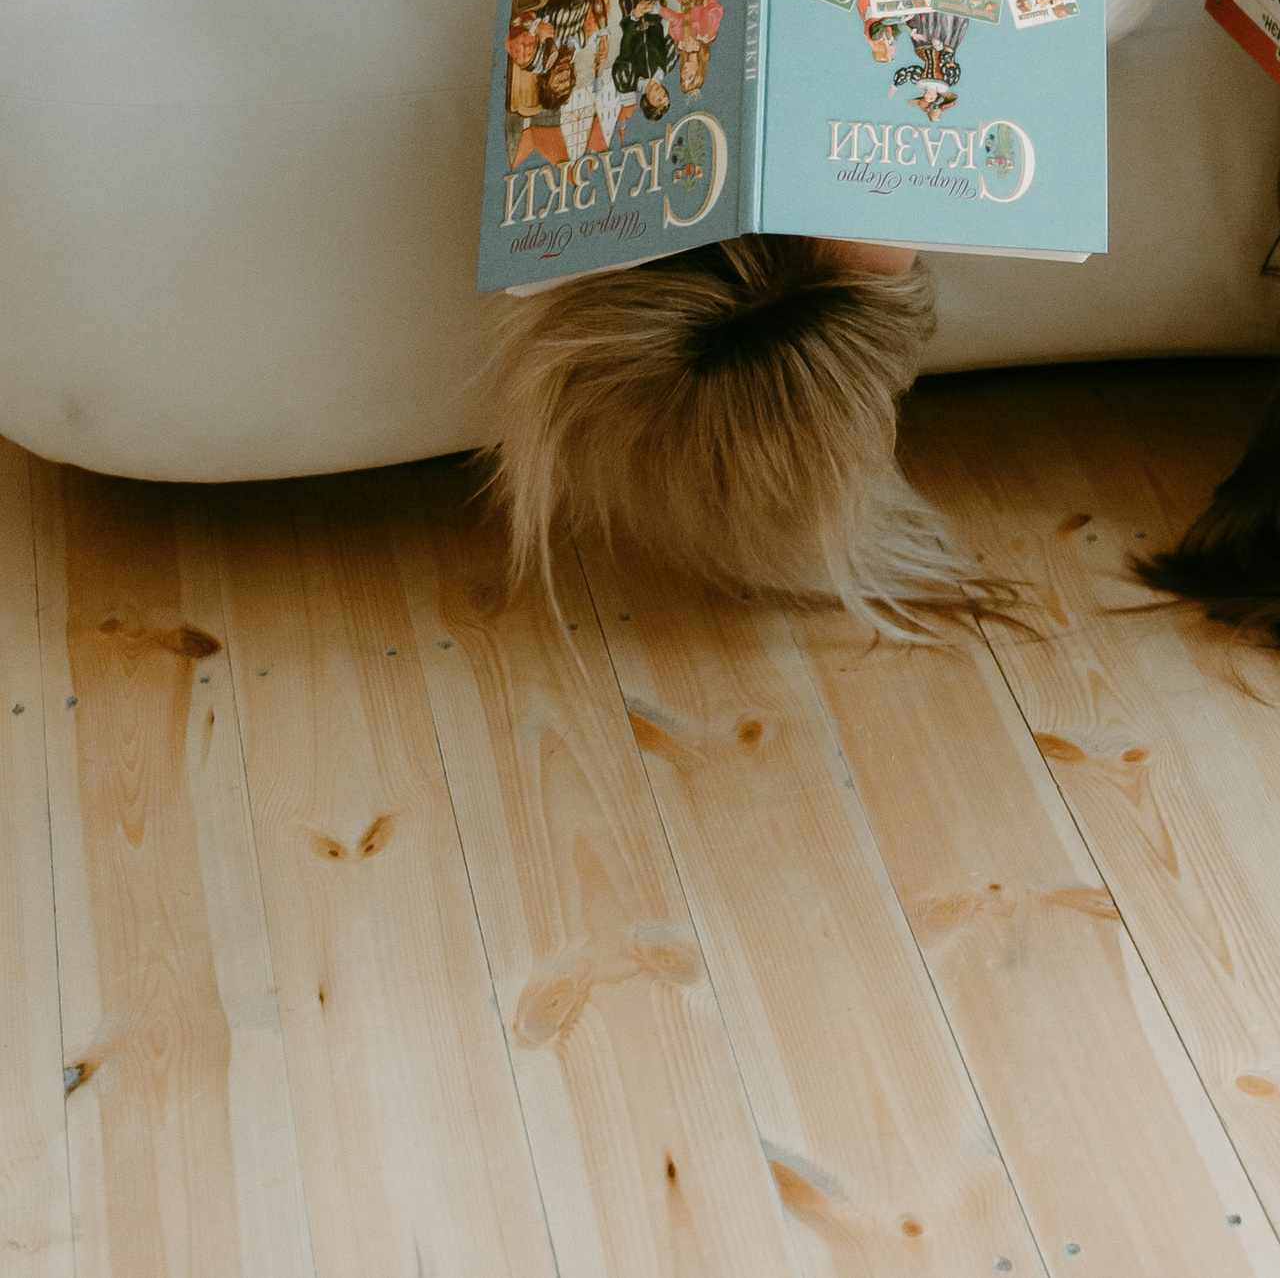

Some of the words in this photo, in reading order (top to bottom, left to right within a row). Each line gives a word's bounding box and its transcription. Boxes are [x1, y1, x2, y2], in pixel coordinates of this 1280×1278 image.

[836, 162, 902, 196] Перро
[909, 168, 977, 200] Шарль
[579, 207, 647, 242] Шарль
[509, 223, 573, 262] Перро
